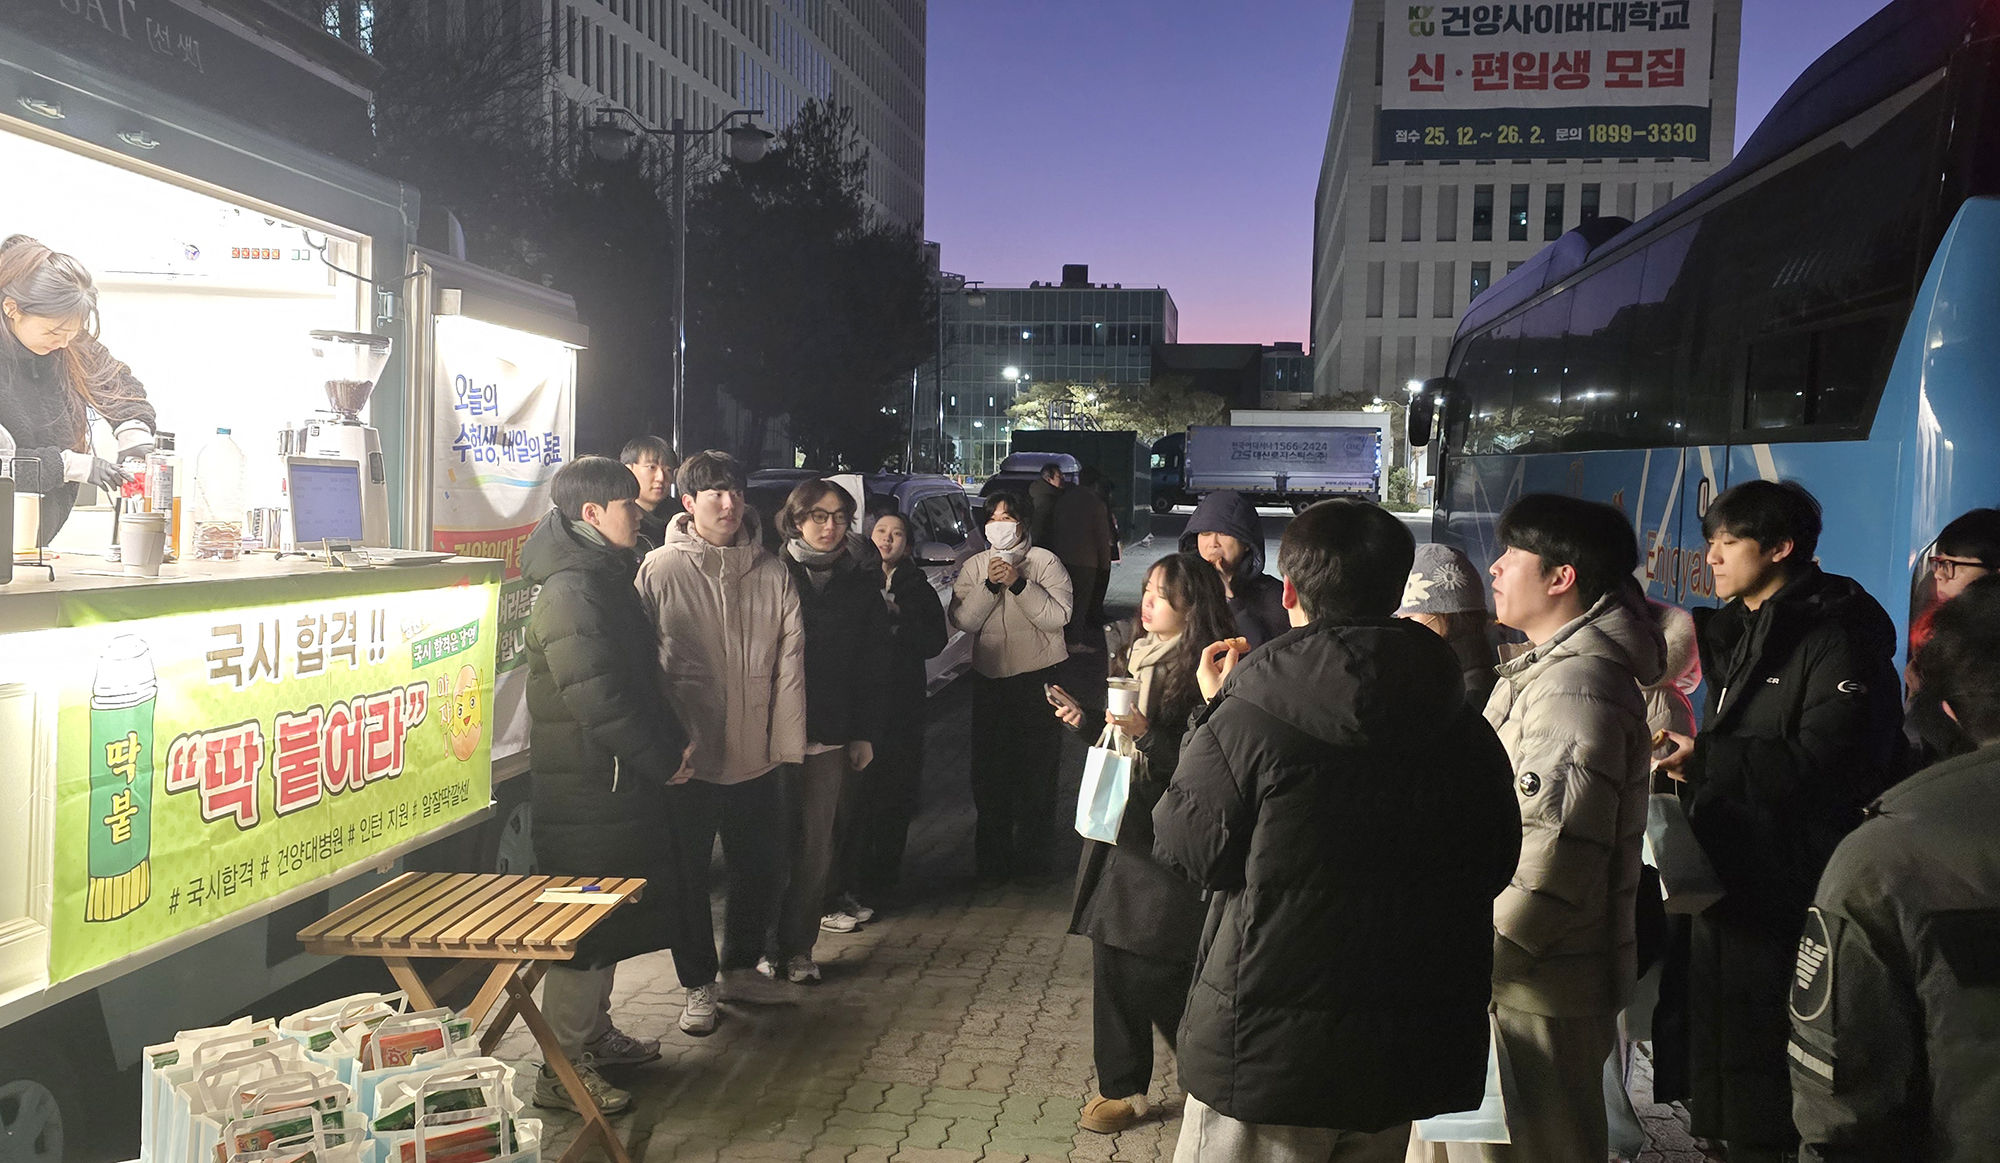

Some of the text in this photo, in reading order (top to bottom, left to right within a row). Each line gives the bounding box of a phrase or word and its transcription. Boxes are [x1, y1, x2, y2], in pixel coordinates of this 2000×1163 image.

[1441, 0, 1690, 37] 건양사이버대학교
[1604, 48, 1685, 89] 모집
[1395, 129, 1420, 143] 접수
[1424, 126, 1449, 145] 25.
[1497, 125, 1523, 144] 26.
[1530, 126, 1545, 144] 2.
[1555, 127, 1582, 141] 문의
[1587, 123, 1697, 143] 1899-3330
[454, 373, 499, 417] 오늘의
[452, 422, 563, 466] 수험생, 내일의 동료
[1274, 441, 1328, 451] 1566-2424
[206, 619, 280, 686] 국시
[296, 611, 357, 674] 합격
[369, 609, 385, 661] !!
[414, 625, 477, 664] 국시 합격은 당연
[186, 859, 254, 907] 국시합격
[277, 825, 343, 877] 건양대병원
[360, 811, 383, 843] 인턴
[387, 801, 409, 829] 지원
[422, 778, 470, 818] 알잘딱깔센
